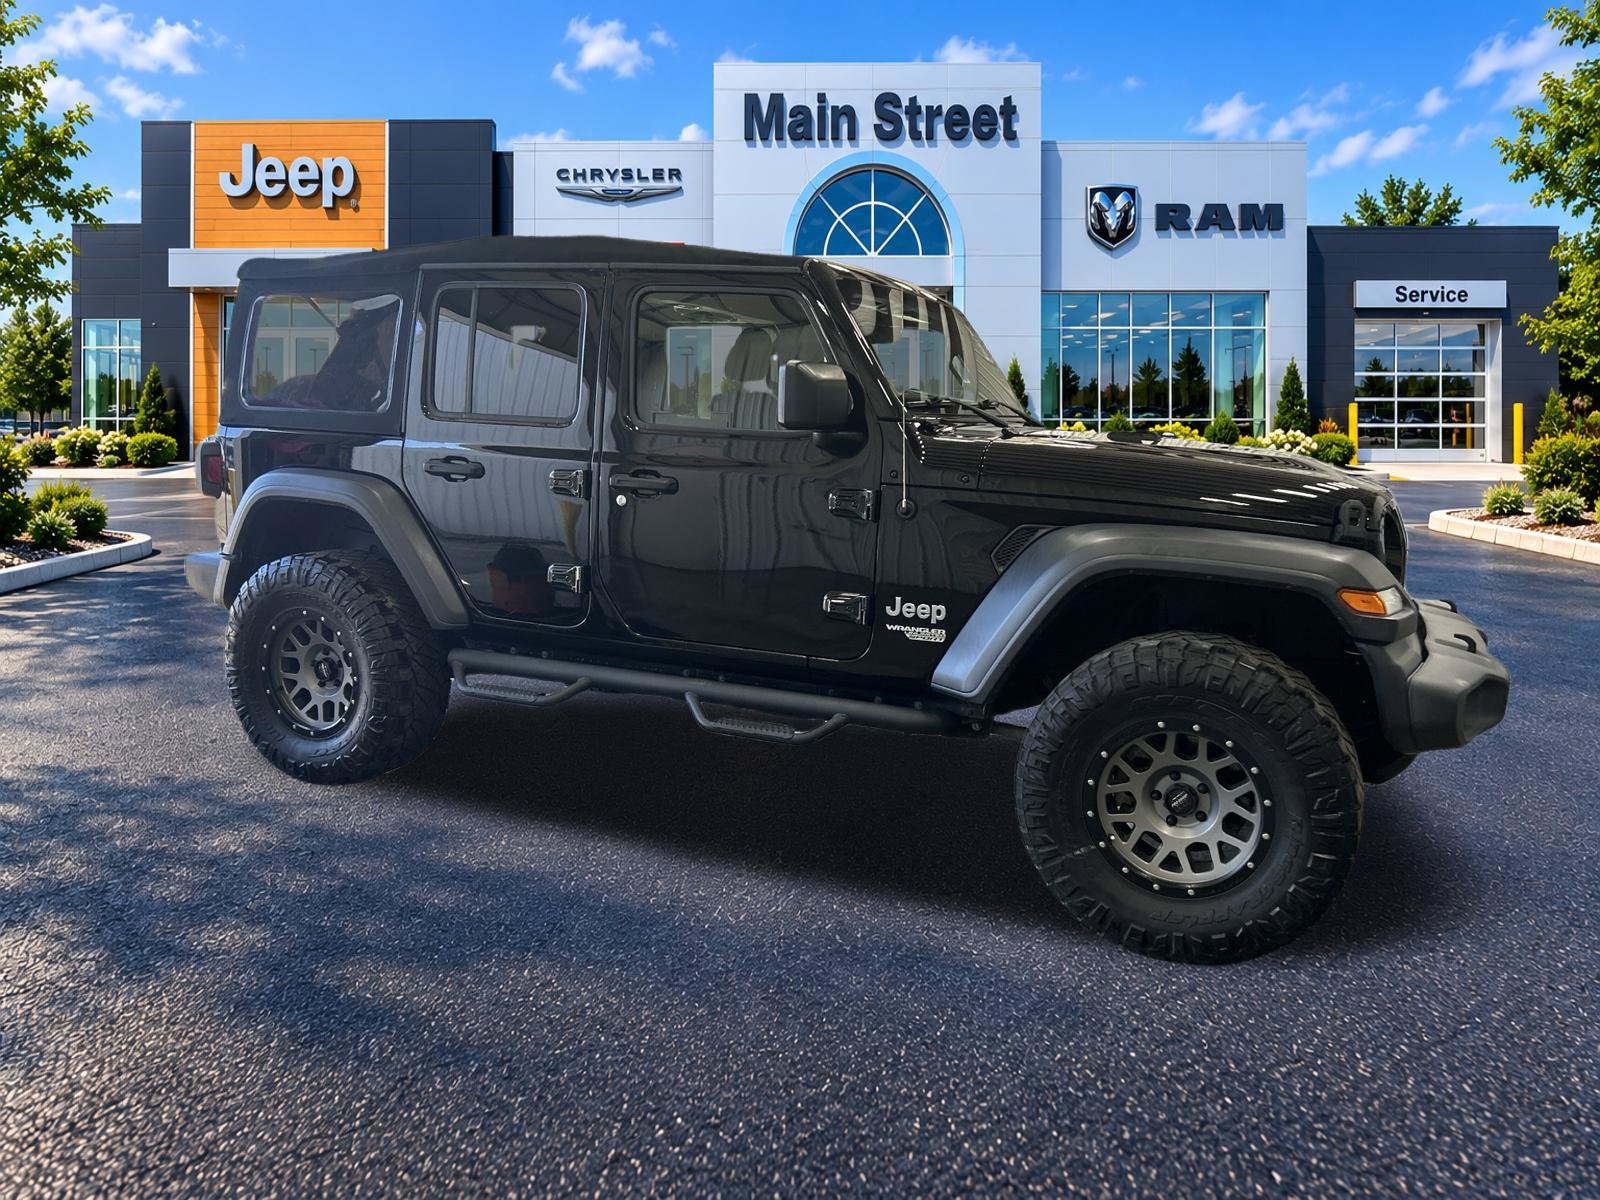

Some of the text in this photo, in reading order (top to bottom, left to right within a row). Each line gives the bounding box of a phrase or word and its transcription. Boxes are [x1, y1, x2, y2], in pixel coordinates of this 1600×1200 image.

[744, 91, 1018, 141] Main Street
[219, 143, 355, 208] Jeep
[556, 168, 683, 183] CHRYSLER
[1155, 203, 1284, 231] RAM
[1395, 285, 1469, 303] Service
[885, 596, 946, 624] Jeep
[885, 623, 946, 635] WRANGLER
